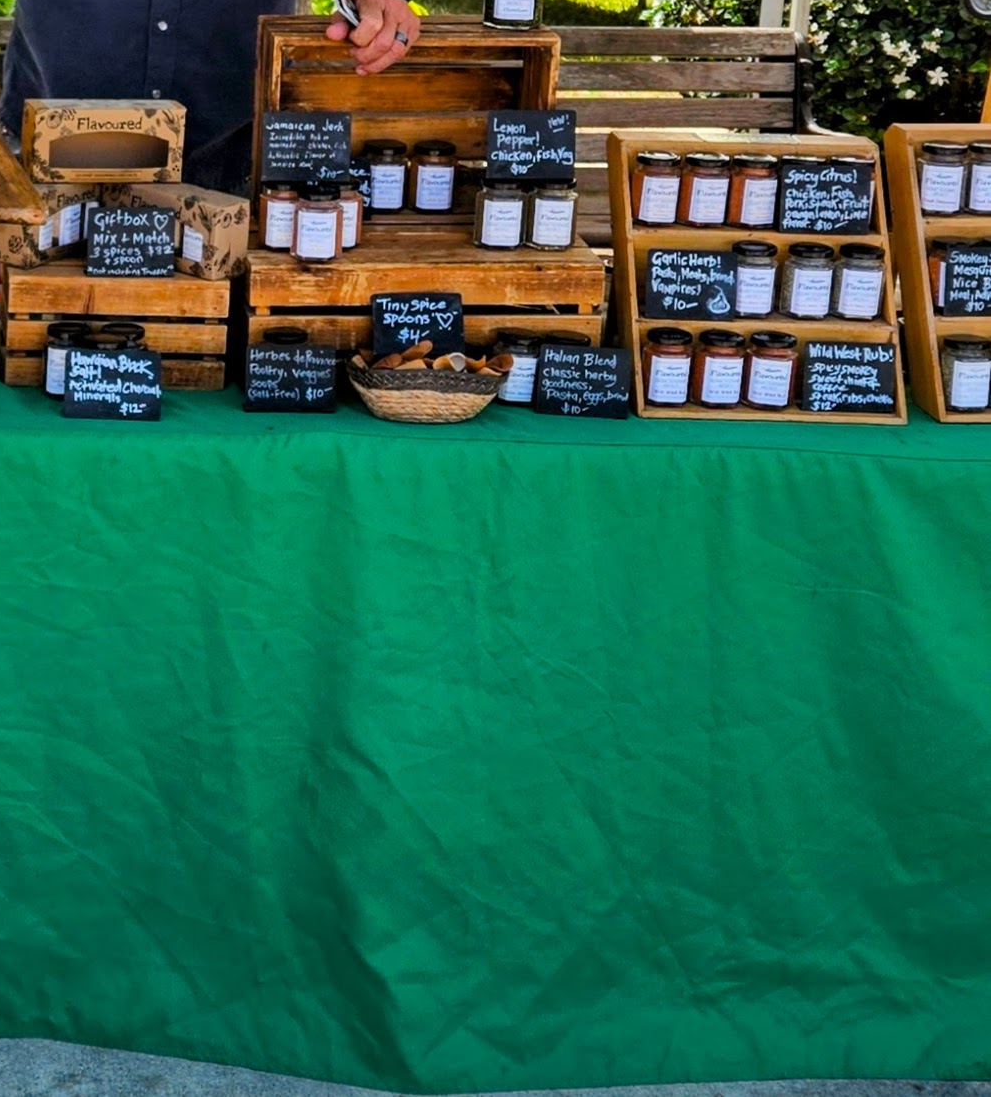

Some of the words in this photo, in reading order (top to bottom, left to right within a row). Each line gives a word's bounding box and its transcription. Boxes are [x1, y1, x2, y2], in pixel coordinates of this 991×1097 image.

[77, 117, 143, 131] Flavoured
[266, 122, 315, 131] Jamaican
[322, 118, 344, 132] Jerk
[493, 117, 527, 134] Lemon
[784, 169, 819, 188] Spicy
[94, 209, 150, 231] Giftbox
[94, 231, 118, 245] Mix
[133, 230, 170, 244] Match
[103, 244, 141, 258] spices
[652, 251, 688, 266] Garlic
[113, 255, 144, 266] spoon
[952, 277, 978, 289] Nice
[376, 298, 410, 315] Tiny
[250, 349, 291, 361] Herbes
[545, 349, 580, 364] Italian
[583, 353, 617, 369] Blend
[809, 343, 833, 359] Wild
[834, 345, 862, 361] West
[584, 369, 617, 388] herby
[74, 392, 121, 403] Minerals
